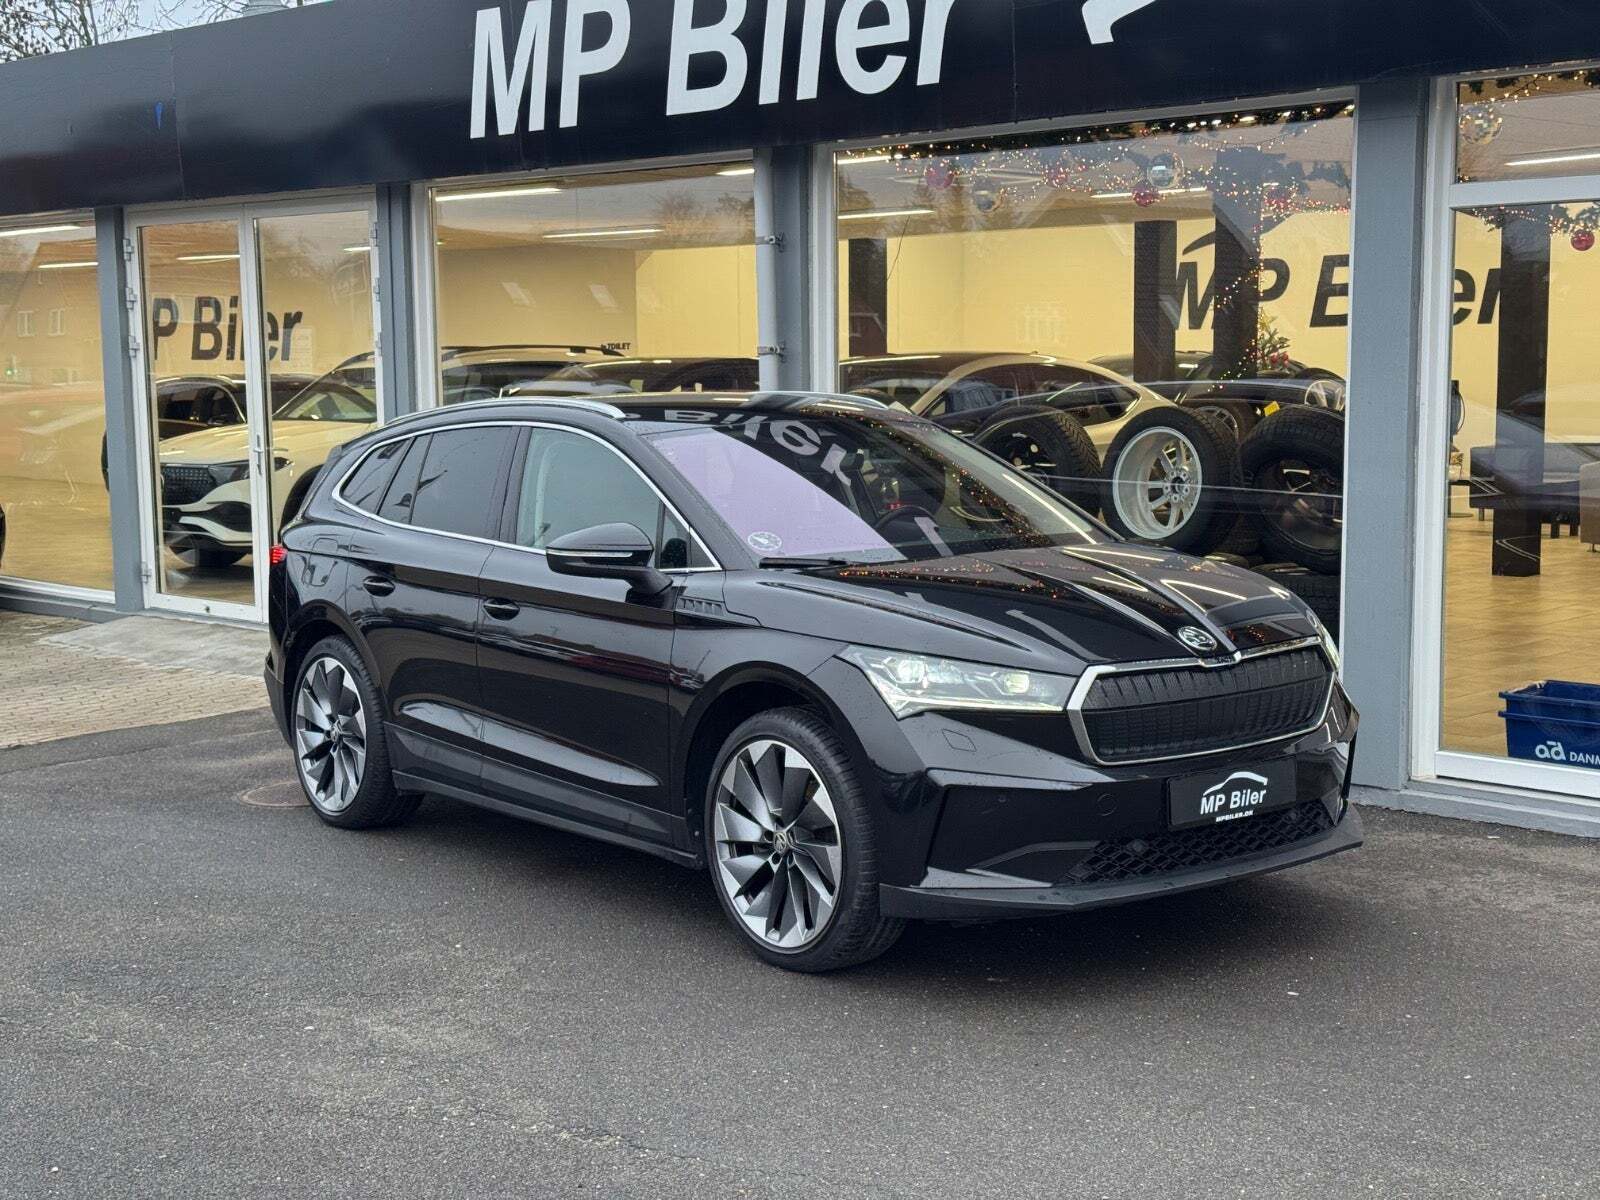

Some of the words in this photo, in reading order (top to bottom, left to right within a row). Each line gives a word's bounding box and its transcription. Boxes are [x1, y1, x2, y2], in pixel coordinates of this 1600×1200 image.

[469, 0, 631, 139] MP
[666, 0, 959, 116] Biler
[152, 297, 180, 361] P
[1200, 794, 1226, 815] MP
[1229, 788, 1267, 809] Biler
